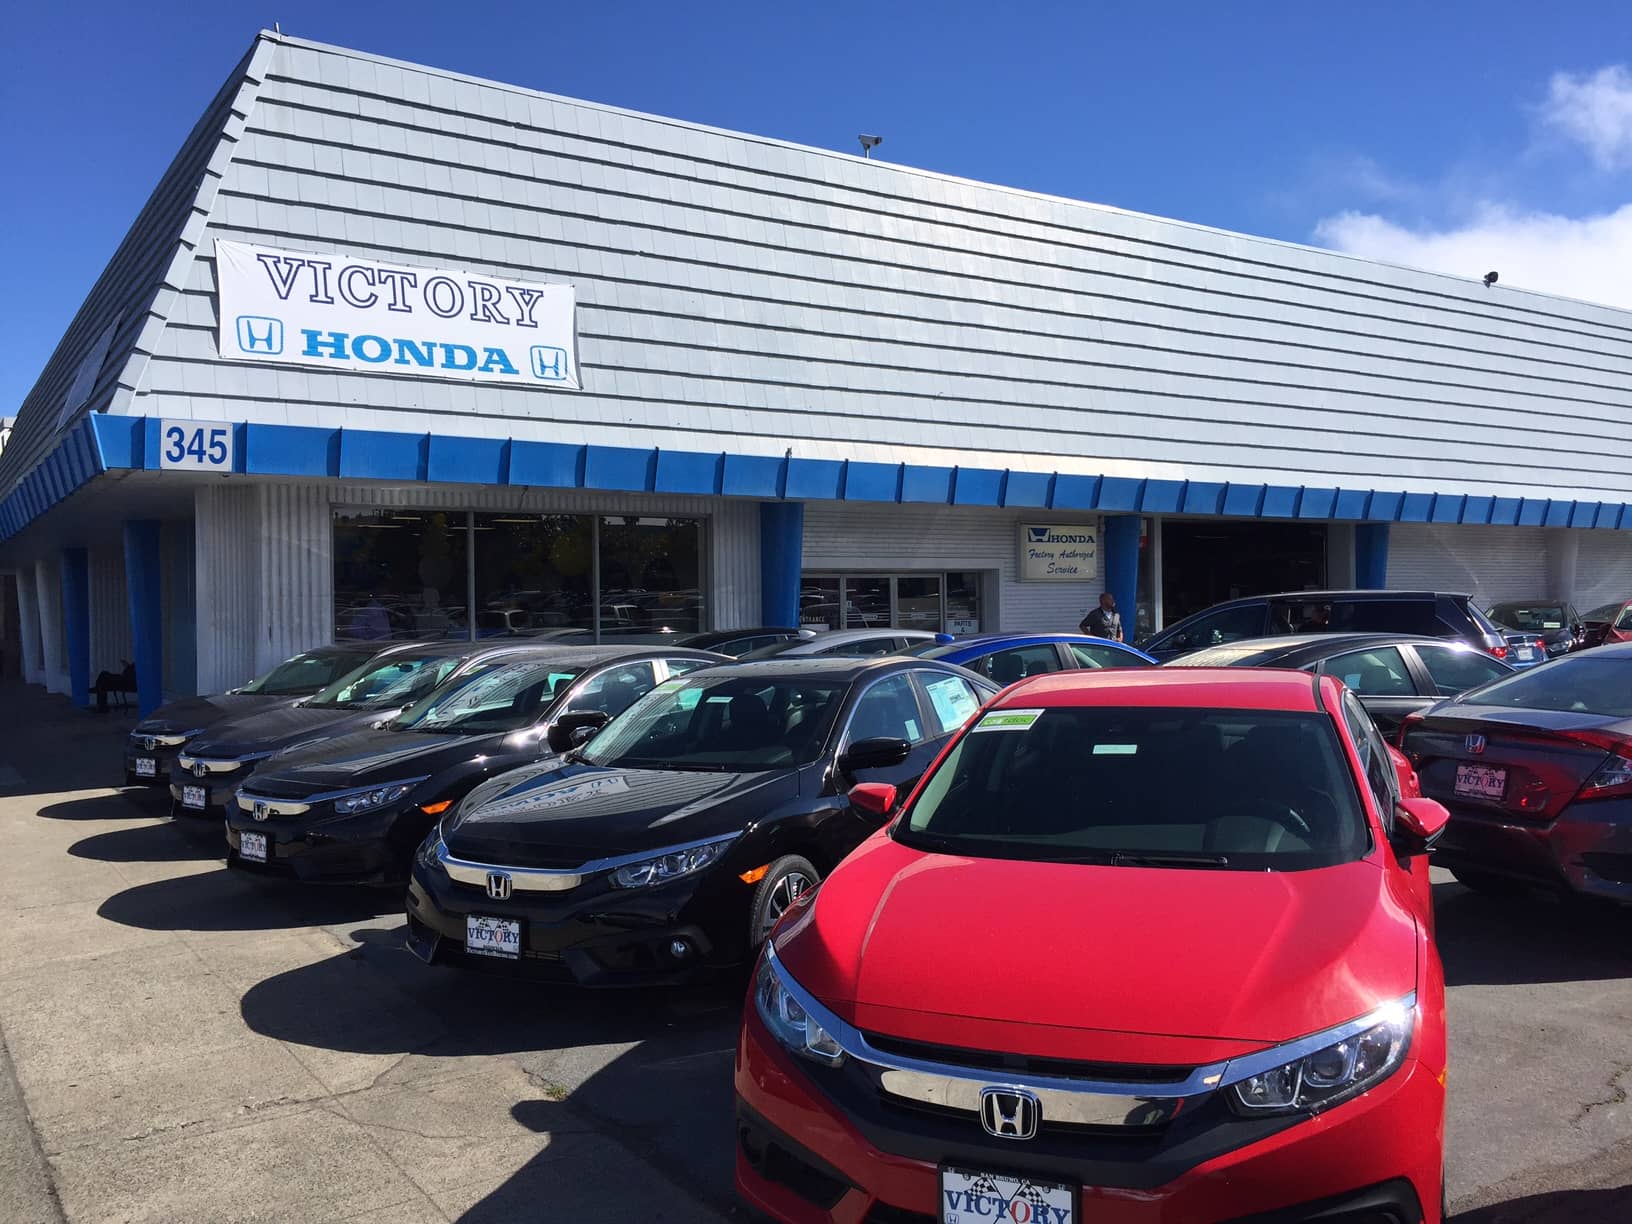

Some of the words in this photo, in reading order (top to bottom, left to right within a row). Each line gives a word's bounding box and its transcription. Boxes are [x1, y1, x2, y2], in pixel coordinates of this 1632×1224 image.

[256, 253, 544, 328] VICTORY
[301, 328, 519, 375] HONDA
[165, 426, 228, 465] 345
[1051, 534, 1096, 544] HONDA
[1028, 548, 1055, 560] Factory
[1059, 548, 1095, 561] Authorized
[1046, 562, 1079, 574] Service
[1456, 774, 1504, 789] VICTORY
[468, 927, 519, 944] VICTORY
[944, 1189, 1071, 1224] VICTORY
